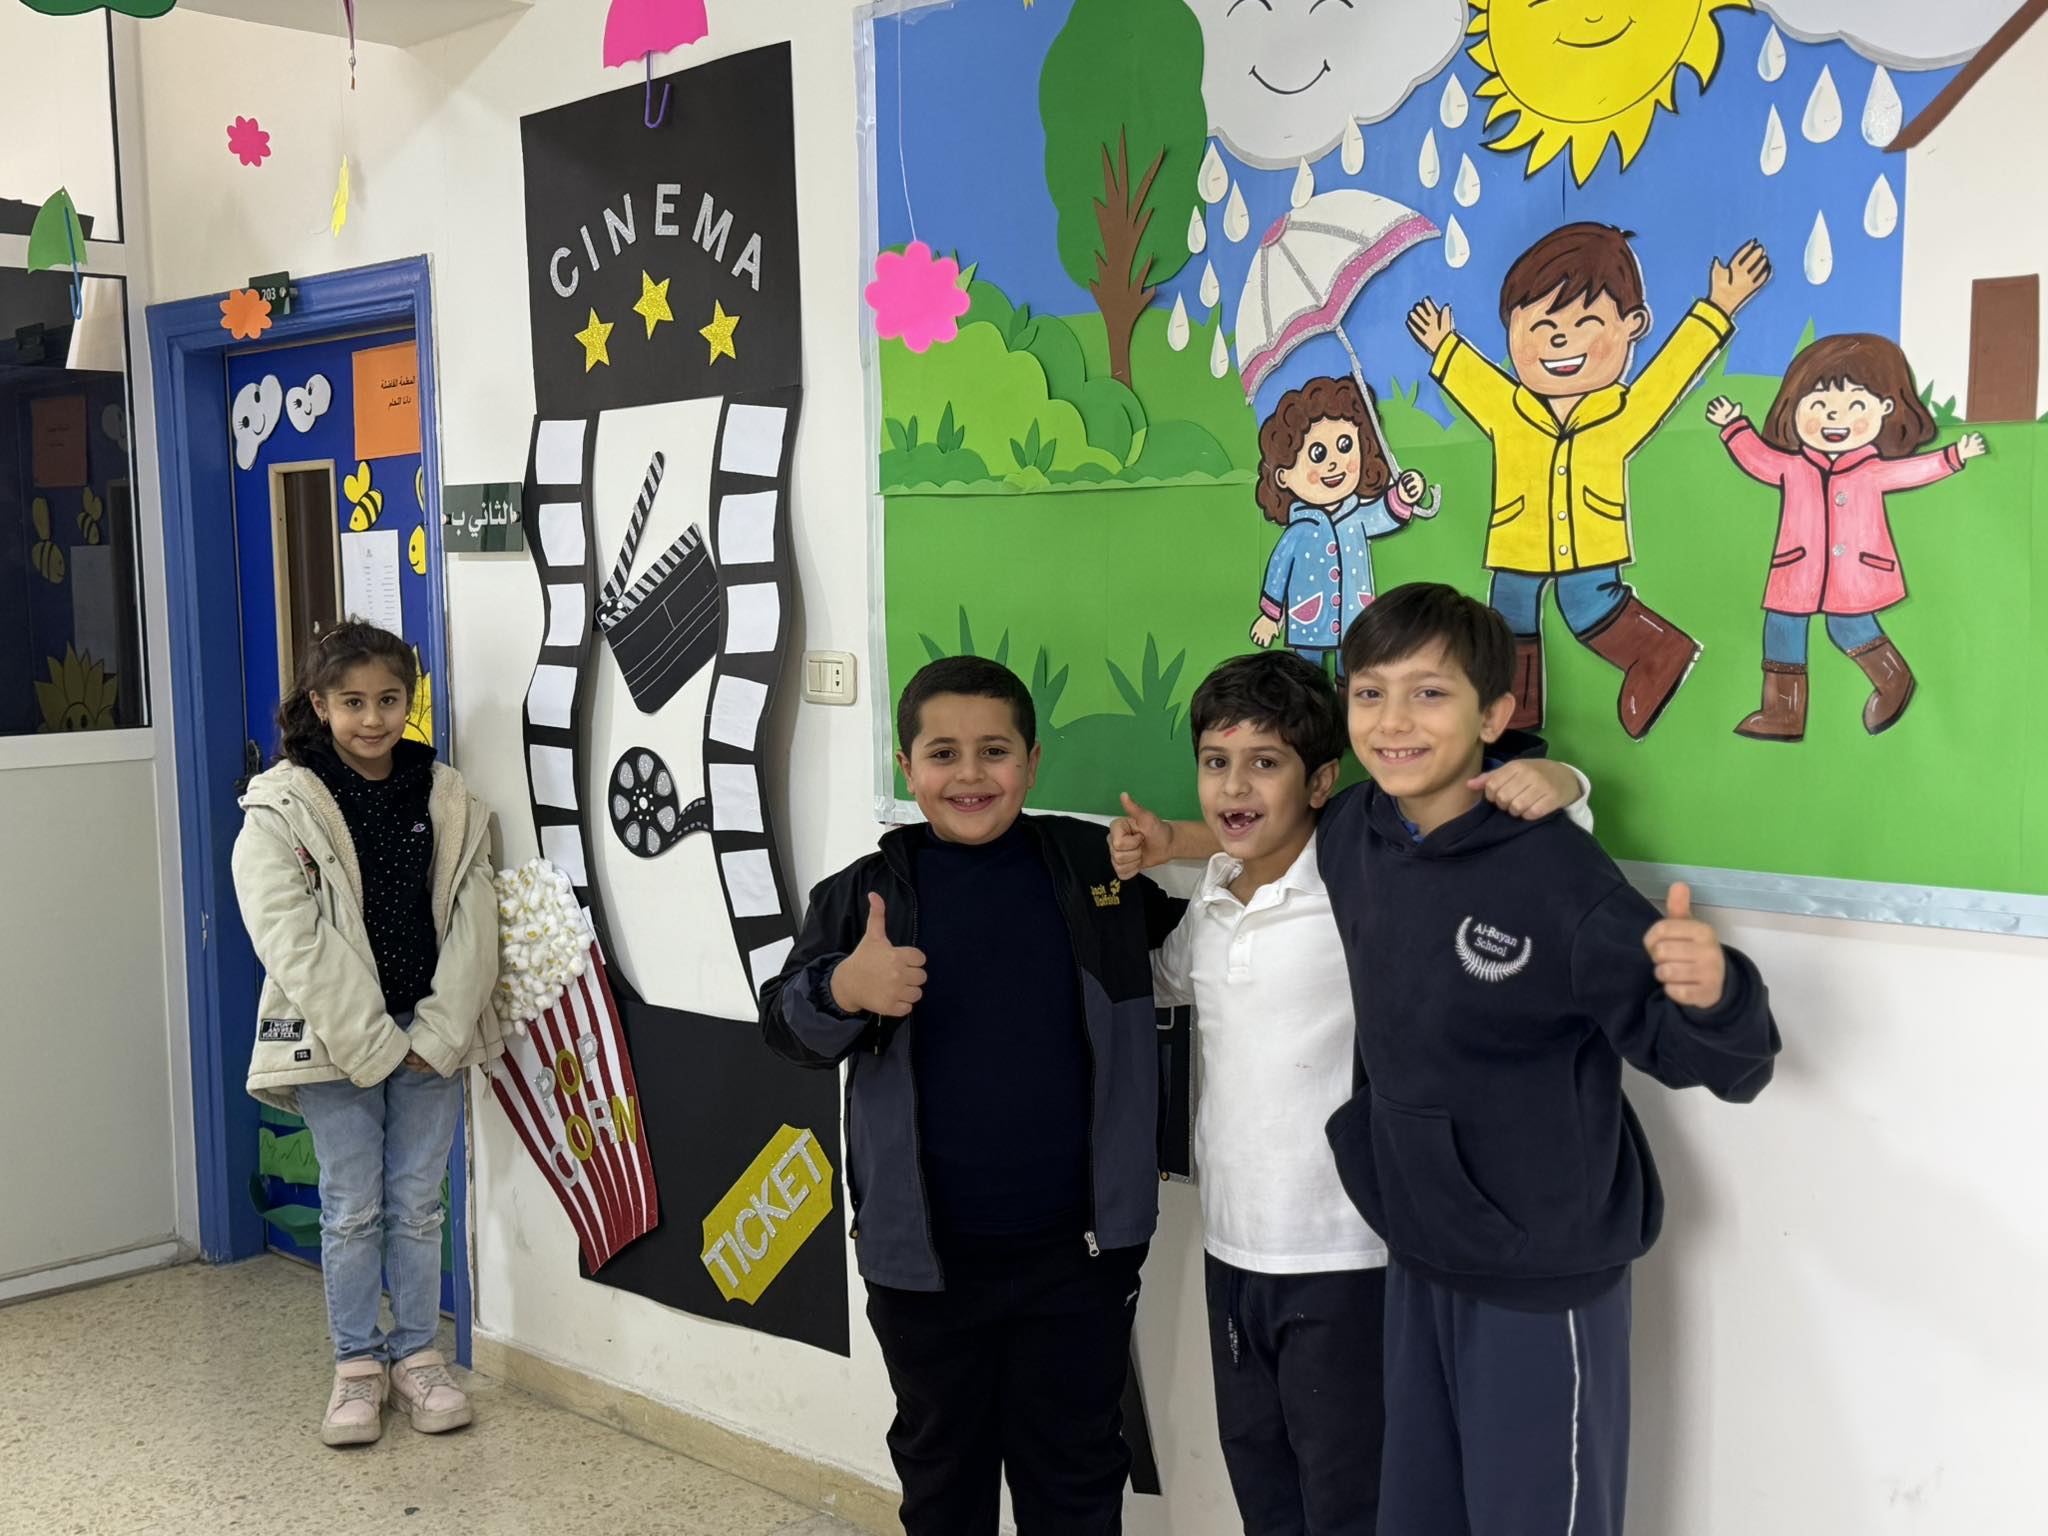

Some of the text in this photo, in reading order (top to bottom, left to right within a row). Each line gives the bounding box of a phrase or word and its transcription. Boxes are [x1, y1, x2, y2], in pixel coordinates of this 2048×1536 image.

[550, 183, 762, 298] CINEMA
[261, 287, 276, 300] 203
[451, 500, 513, 537] الثاني ب
[1473, 922, 1518, 947] Al-Bayan
[1474, 936, 1508, 957] School
[533, 1032, 599, 1118] POP
[551, 1095, 637, 1189] CORN
[703, 1130, 823, 1289] TICKET
